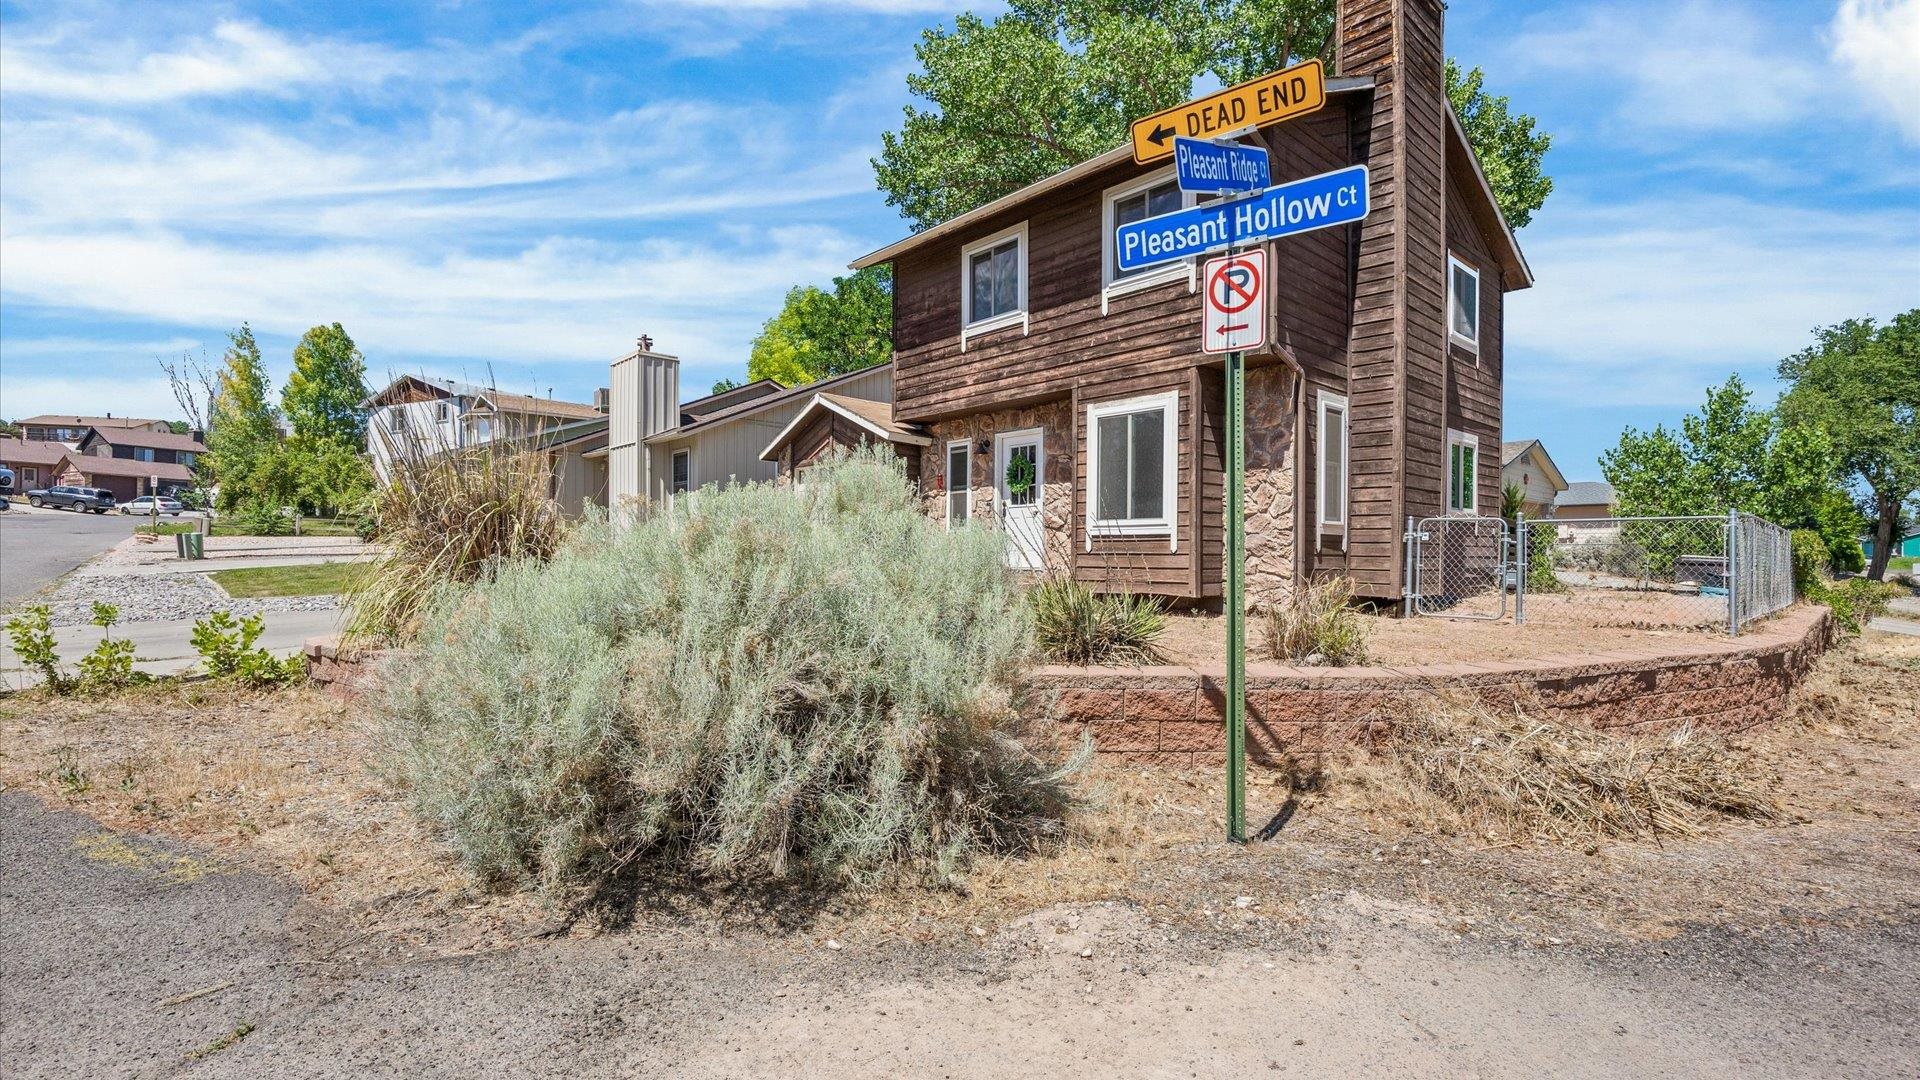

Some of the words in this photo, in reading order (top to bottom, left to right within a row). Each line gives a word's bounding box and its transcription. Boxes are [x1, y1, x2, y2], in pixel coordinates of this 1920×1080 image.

[1187, 97, 1246, 137] DEAD
[1257, 77, 1306, 116] END
[1178, 144, 1229, 181] Pleasant
[1229, 150, 1258, 190] Ridge
[1259, 161, 1267, 178] Ct
[1124, 210, 1228, 261] Pleasant
[1234, 191, 1332, 237] Hollow
[1337, 184, 1357, 207] Ct
[1223, 269, 1250, 304] P
